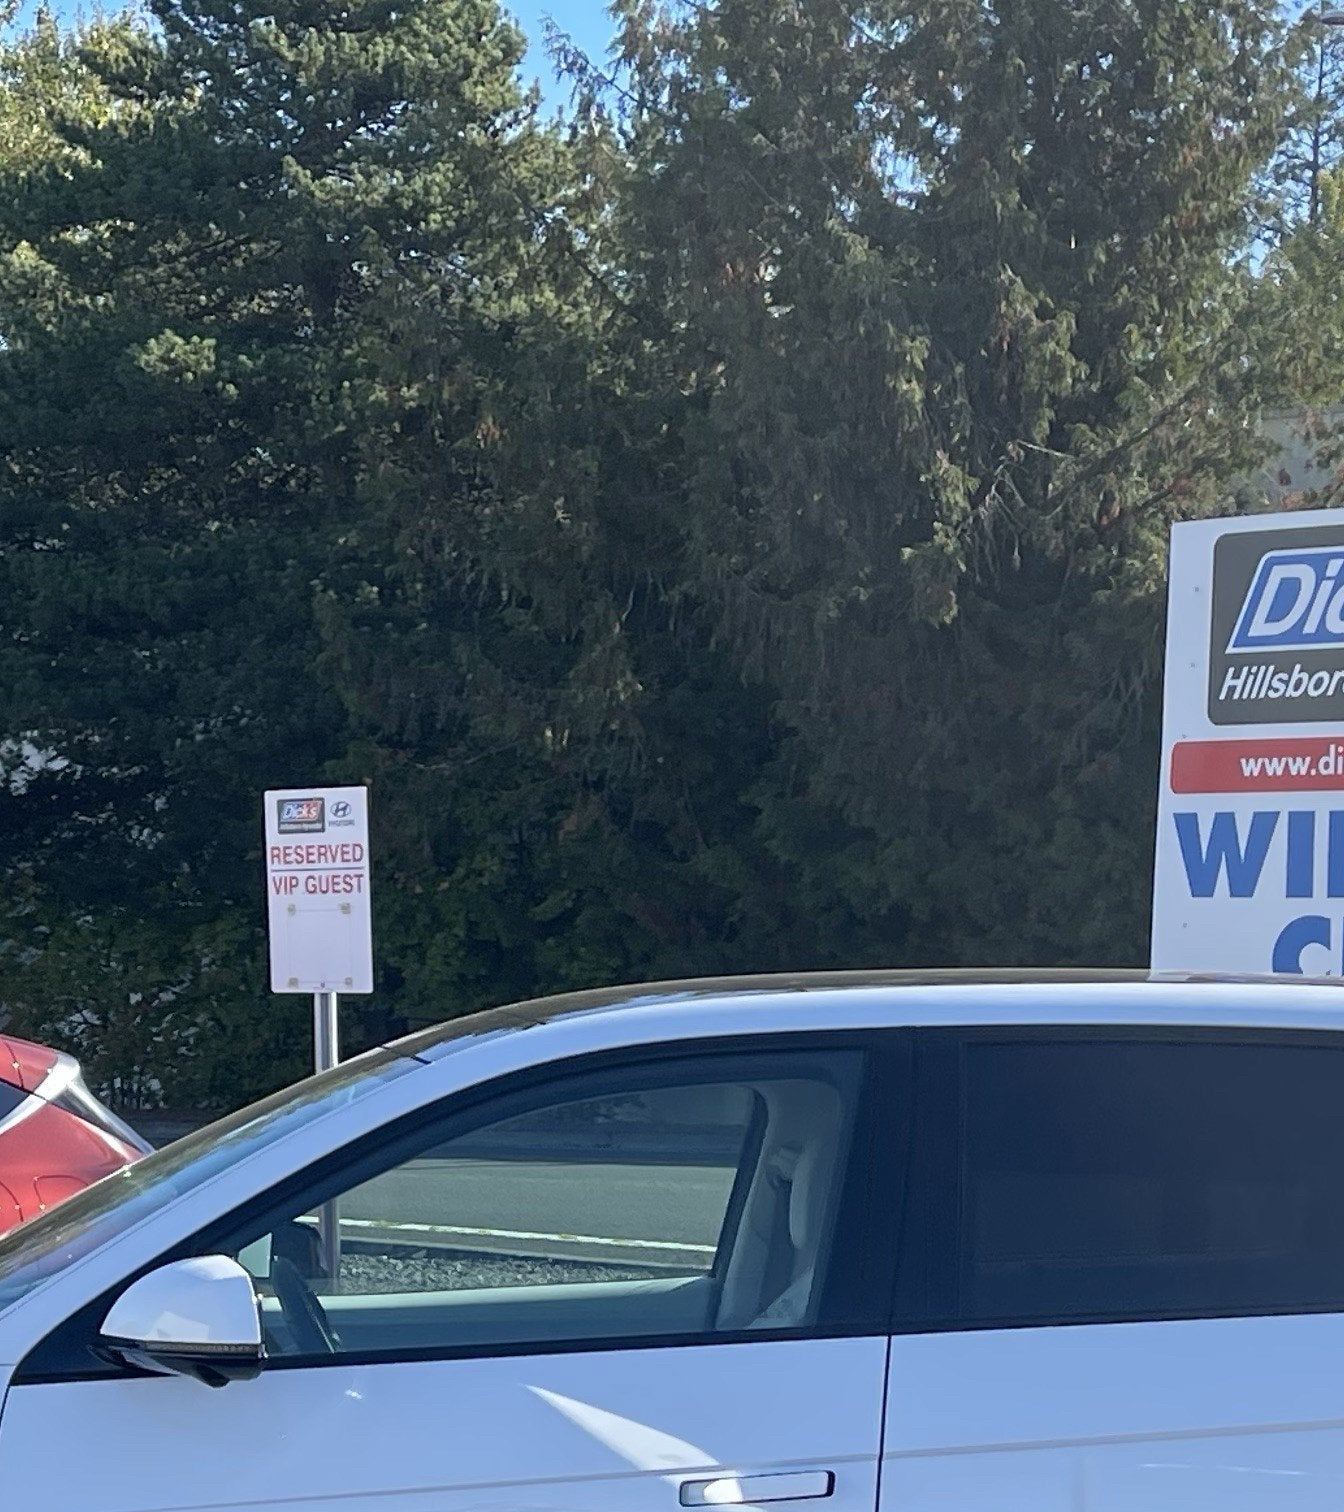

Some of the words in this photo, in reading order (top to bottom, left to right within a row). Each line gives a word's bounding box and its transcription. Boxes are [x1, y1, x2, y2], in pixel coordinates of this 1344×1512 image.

[270, 844, 364, 865] RESERVED
[272, 876, 299, 895] VIP
[306, 874, 364, 894] GUEST
